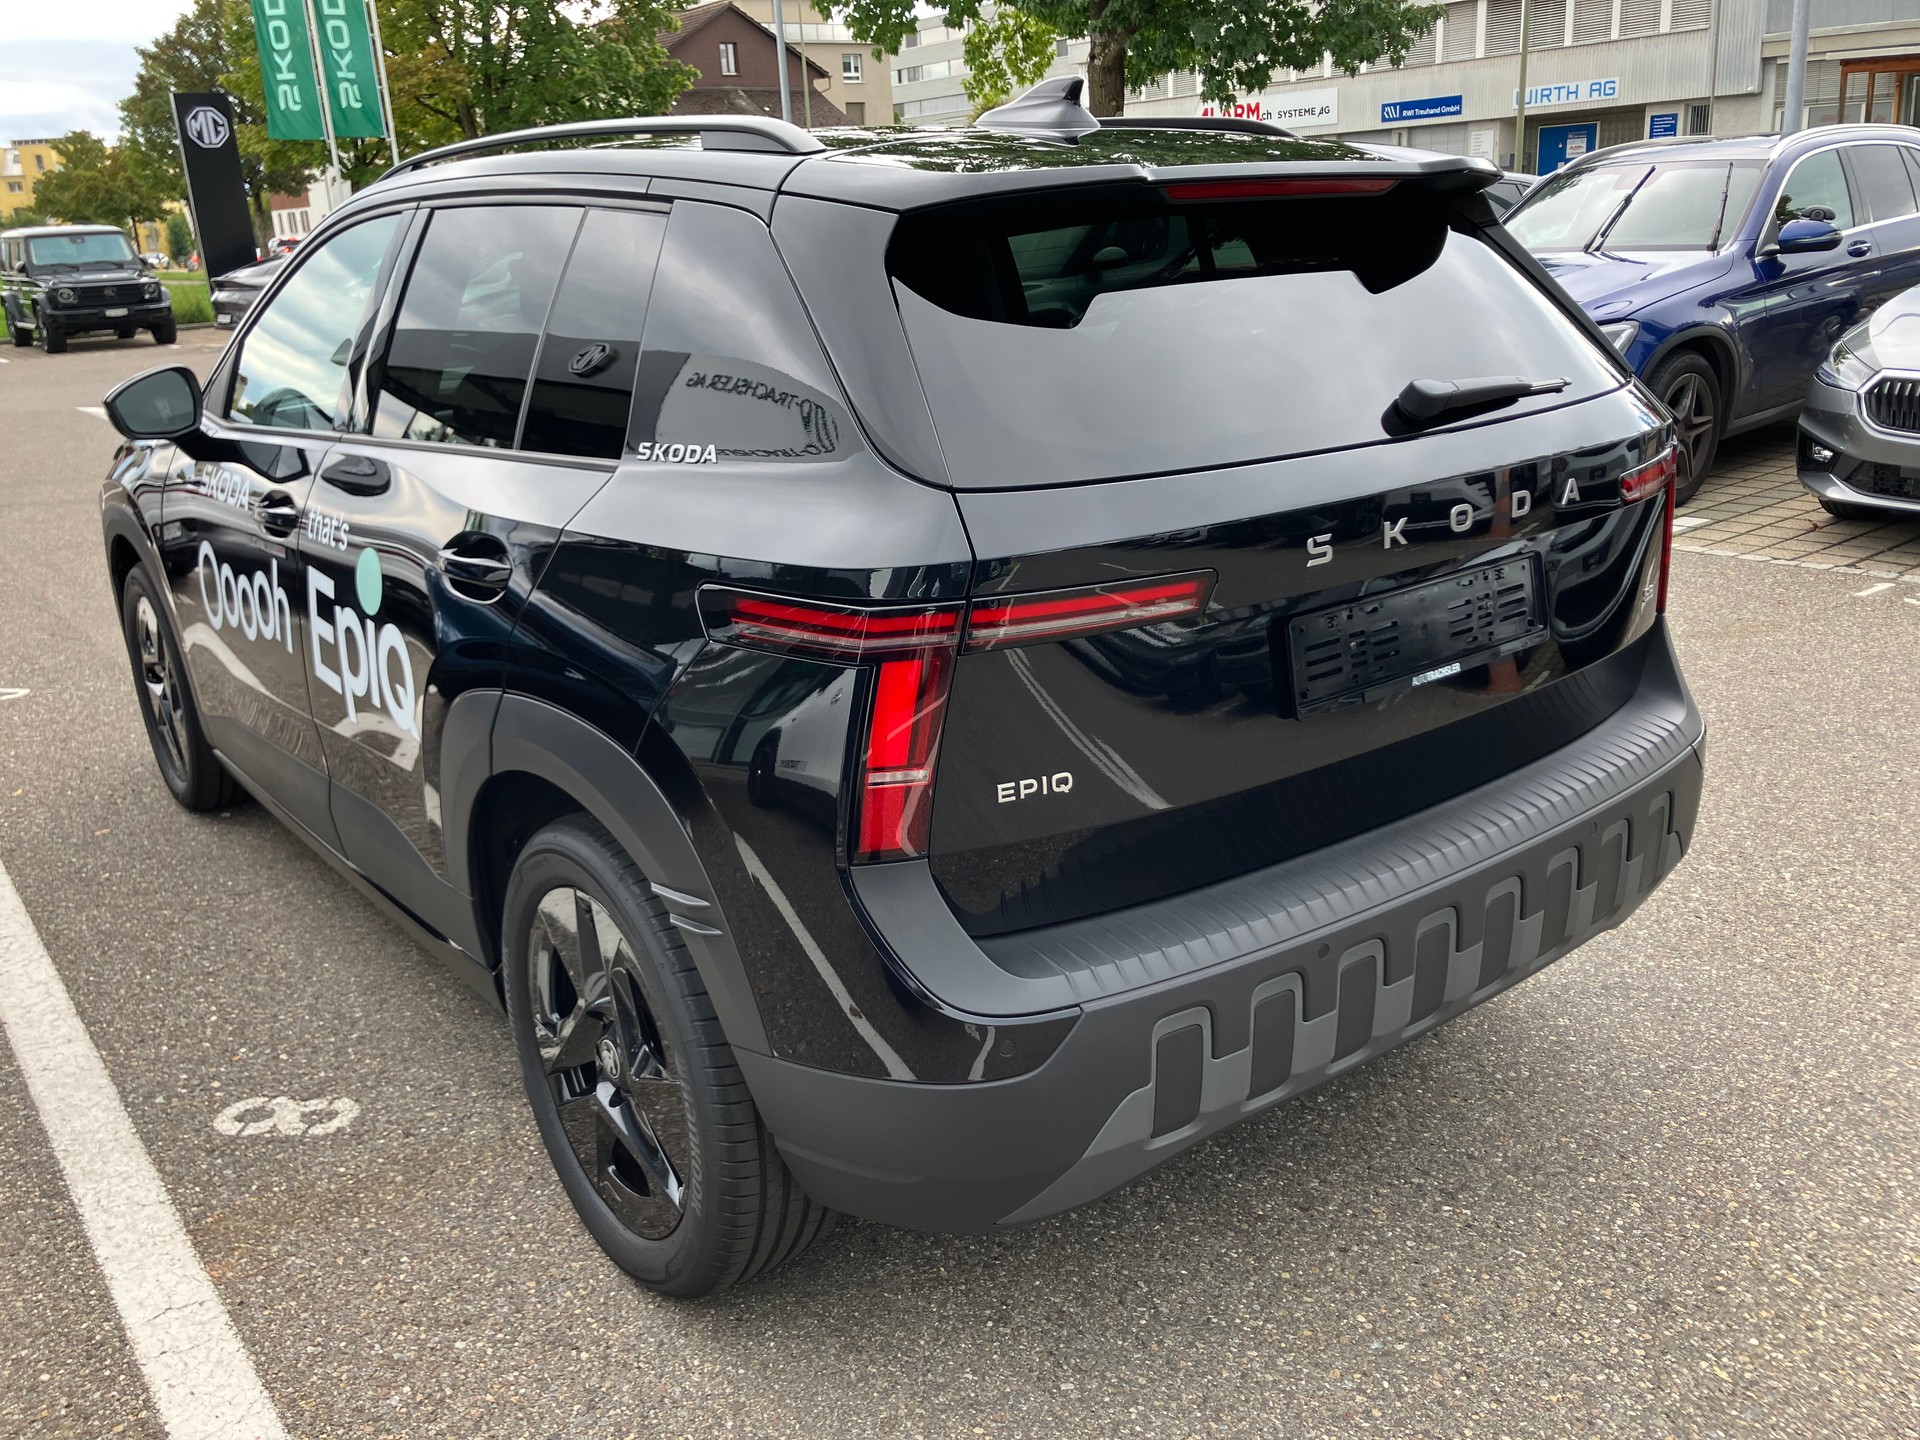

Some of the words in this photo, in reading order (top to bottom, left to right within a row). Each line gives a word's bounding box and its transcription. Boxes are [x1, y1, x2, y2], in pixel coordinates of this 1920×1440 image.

[1589, 80, 1616, 98] AG
[1277, 108, 1316, 119] SYSTEME
[1317, 105, 1330, 117] AG
[1415, 107, 1440, 115] Treuhand
[188, 109, 227, 146] MG
[307, 506, 350, 551] that's
[199, 540, 293, 654] Ooooh
[997, 772, 1073, 803] EPIQ
